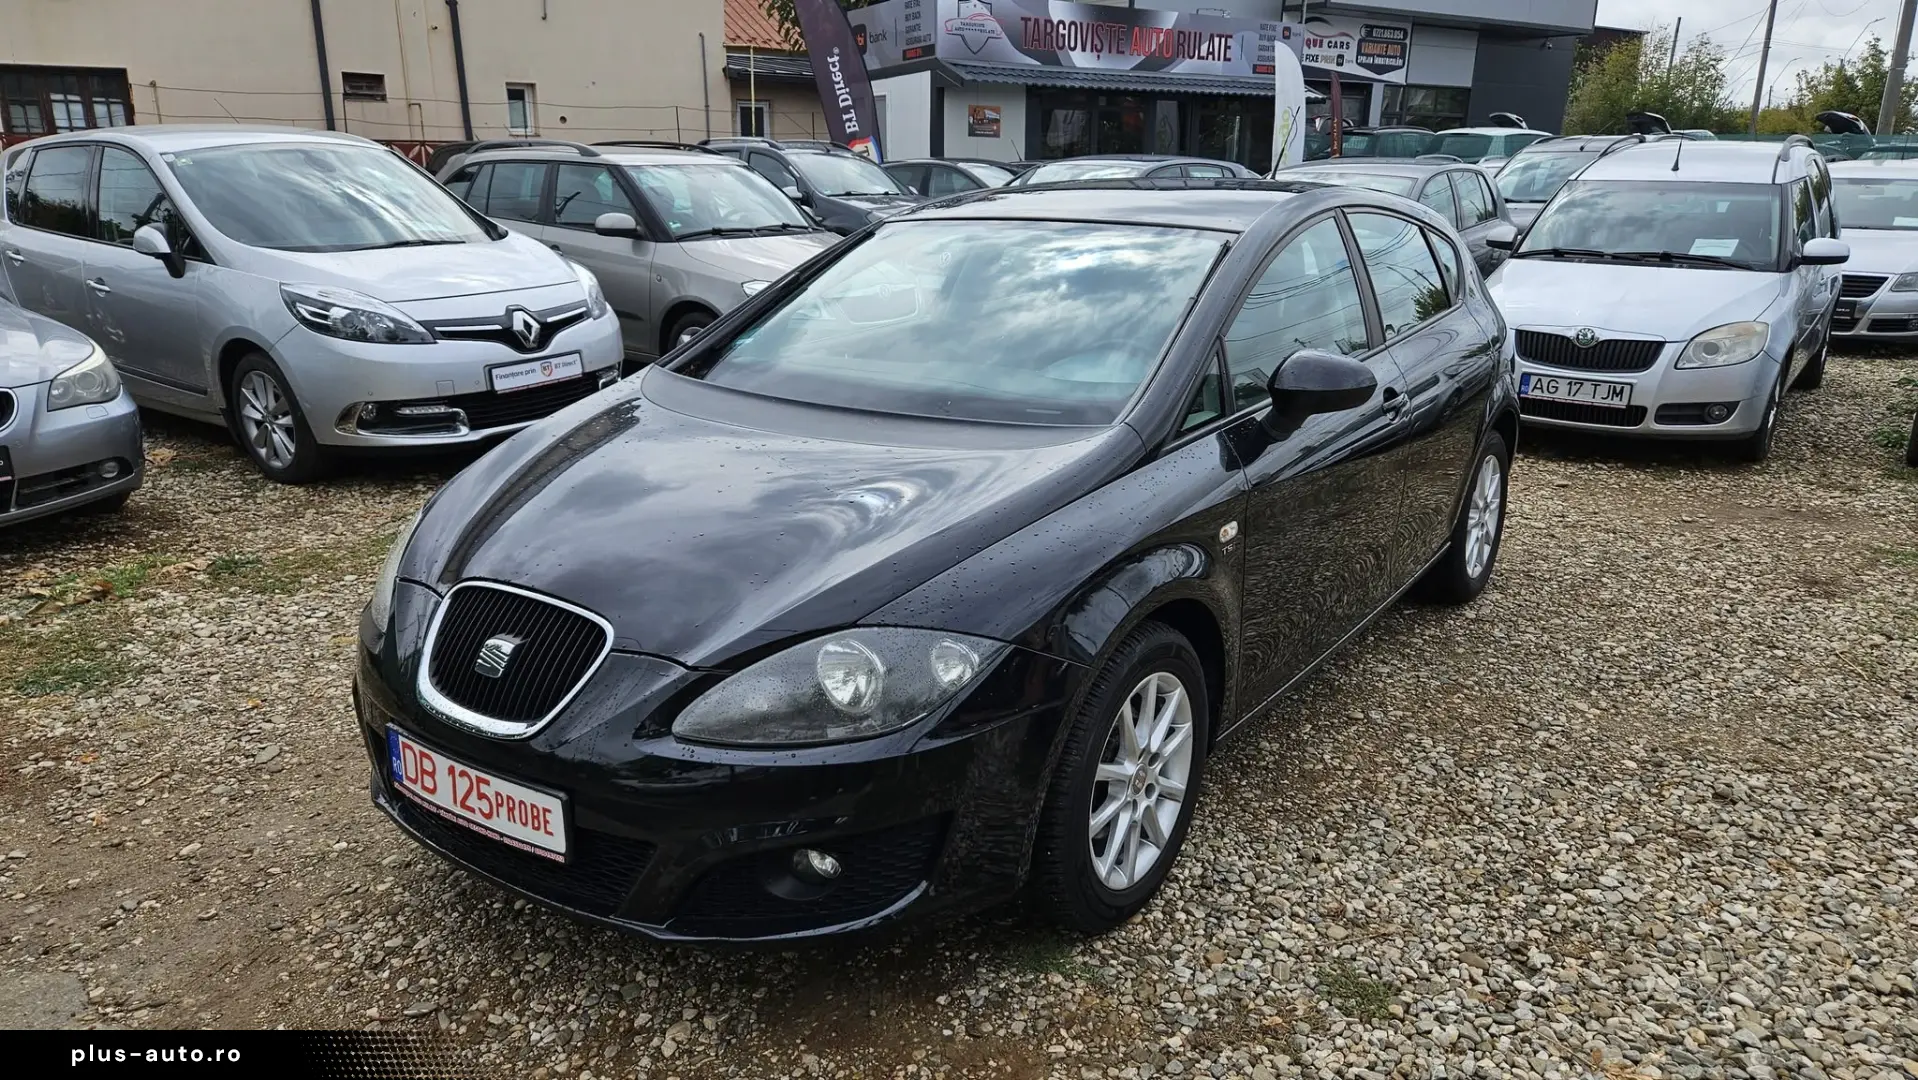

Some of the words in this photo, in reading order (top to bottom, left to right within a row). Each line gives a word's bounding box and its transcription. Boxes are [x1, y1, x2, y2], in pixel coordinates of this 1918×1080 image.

[869, 30, 888, 44] bank
[1129, 26, 1174, 58] AUTO
[1176, 30, 1233, 62] RULATE
[1305, 38, 1324, 49] QUE
[1327, 40, 1350, 50] CARS
[1305, 54, 1319, 62] FIXE
[844, 108, 860, 134] BT
[525, 368, 536, 377] prin
[1531, 378, 1560, 394] AG
[1566, 380, 1584, 397] 17
[1590, 383, 1625, 402] TJM
[392, 757, 402, 775] RO
[400, 740, 438, 796] DB
[447, 764, 494, 820] 125
[494, 790, 554, 836] PROBE
